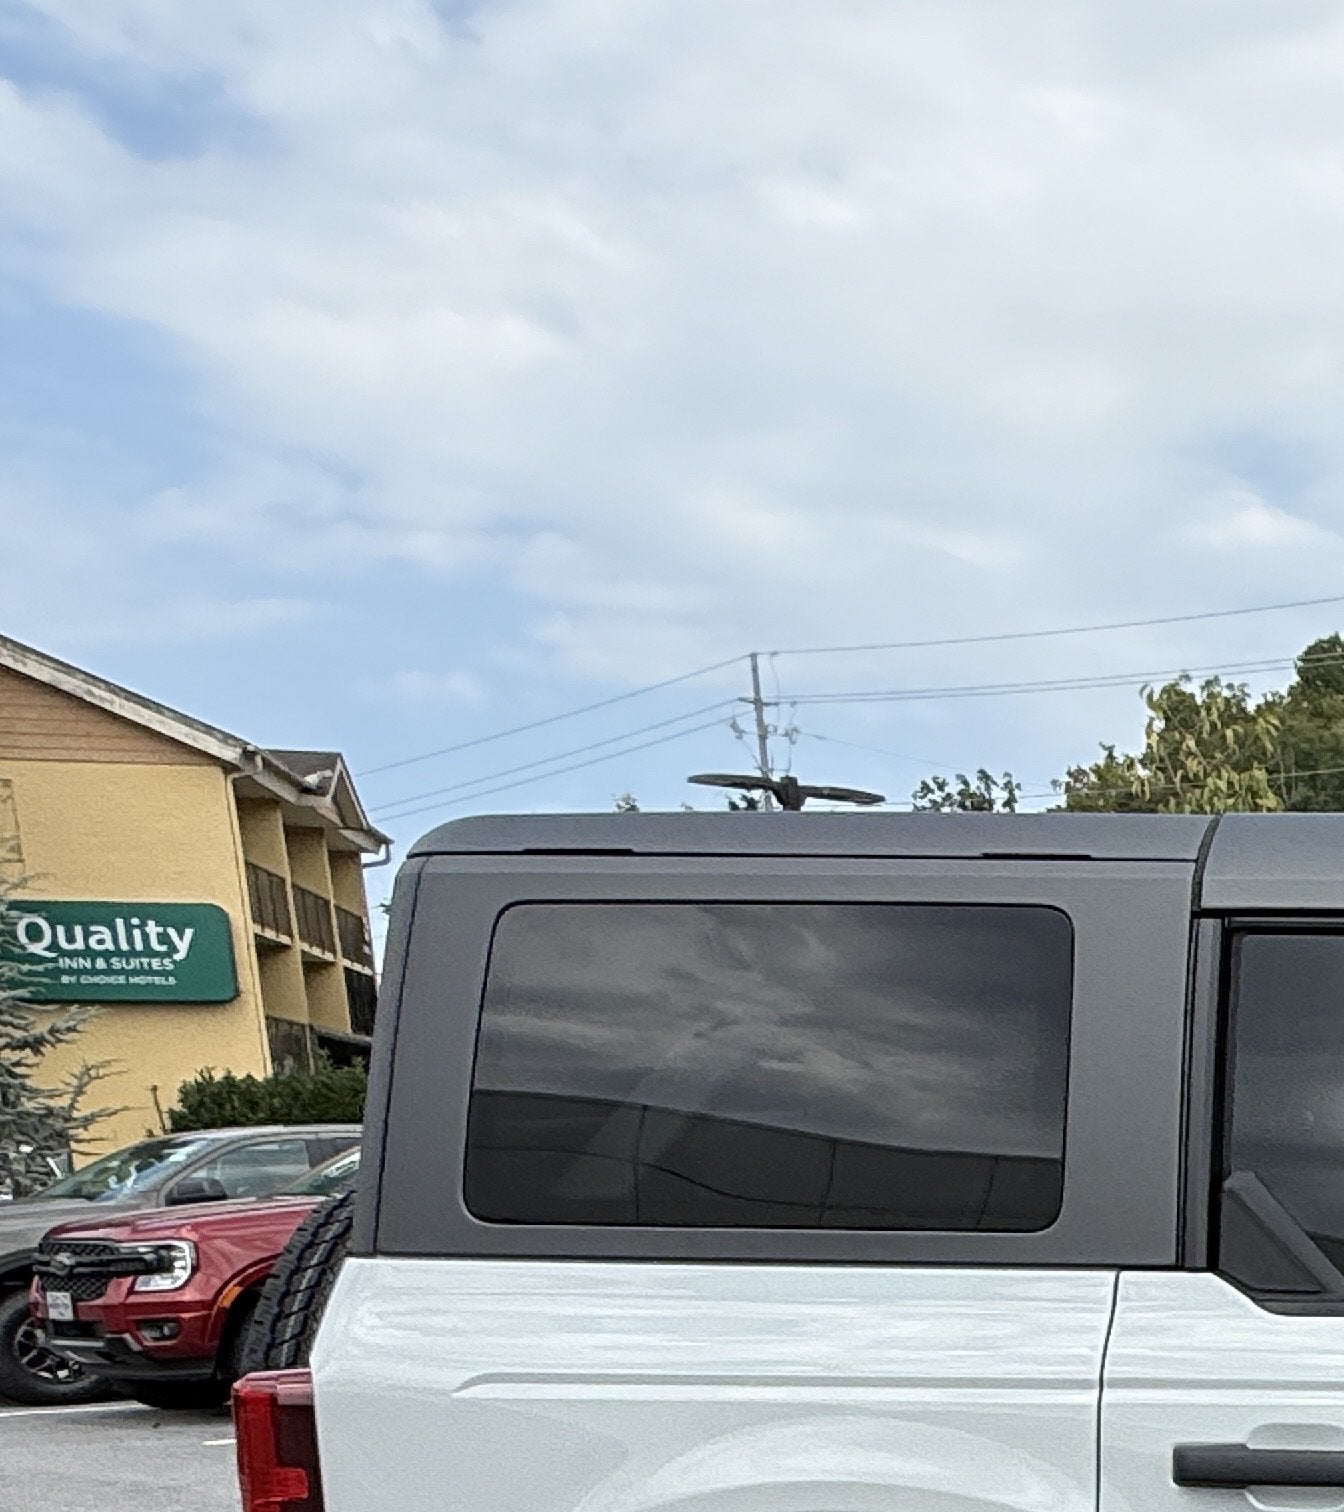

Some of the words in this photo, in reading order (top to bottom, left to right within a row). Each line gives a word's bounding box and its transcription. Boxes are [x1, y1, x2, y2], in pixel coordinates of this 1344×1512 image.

[17, 917, 195, 961] Quality
[59, 957, 91, 970] INN
[95, 957, 107, 970] &
[111, 957, 175, 970] SUITES
[61, 975, 77, 984] BY
[80, 975, 127, 984] CHOICE
[128, 975, 177, 986] HOTELS
